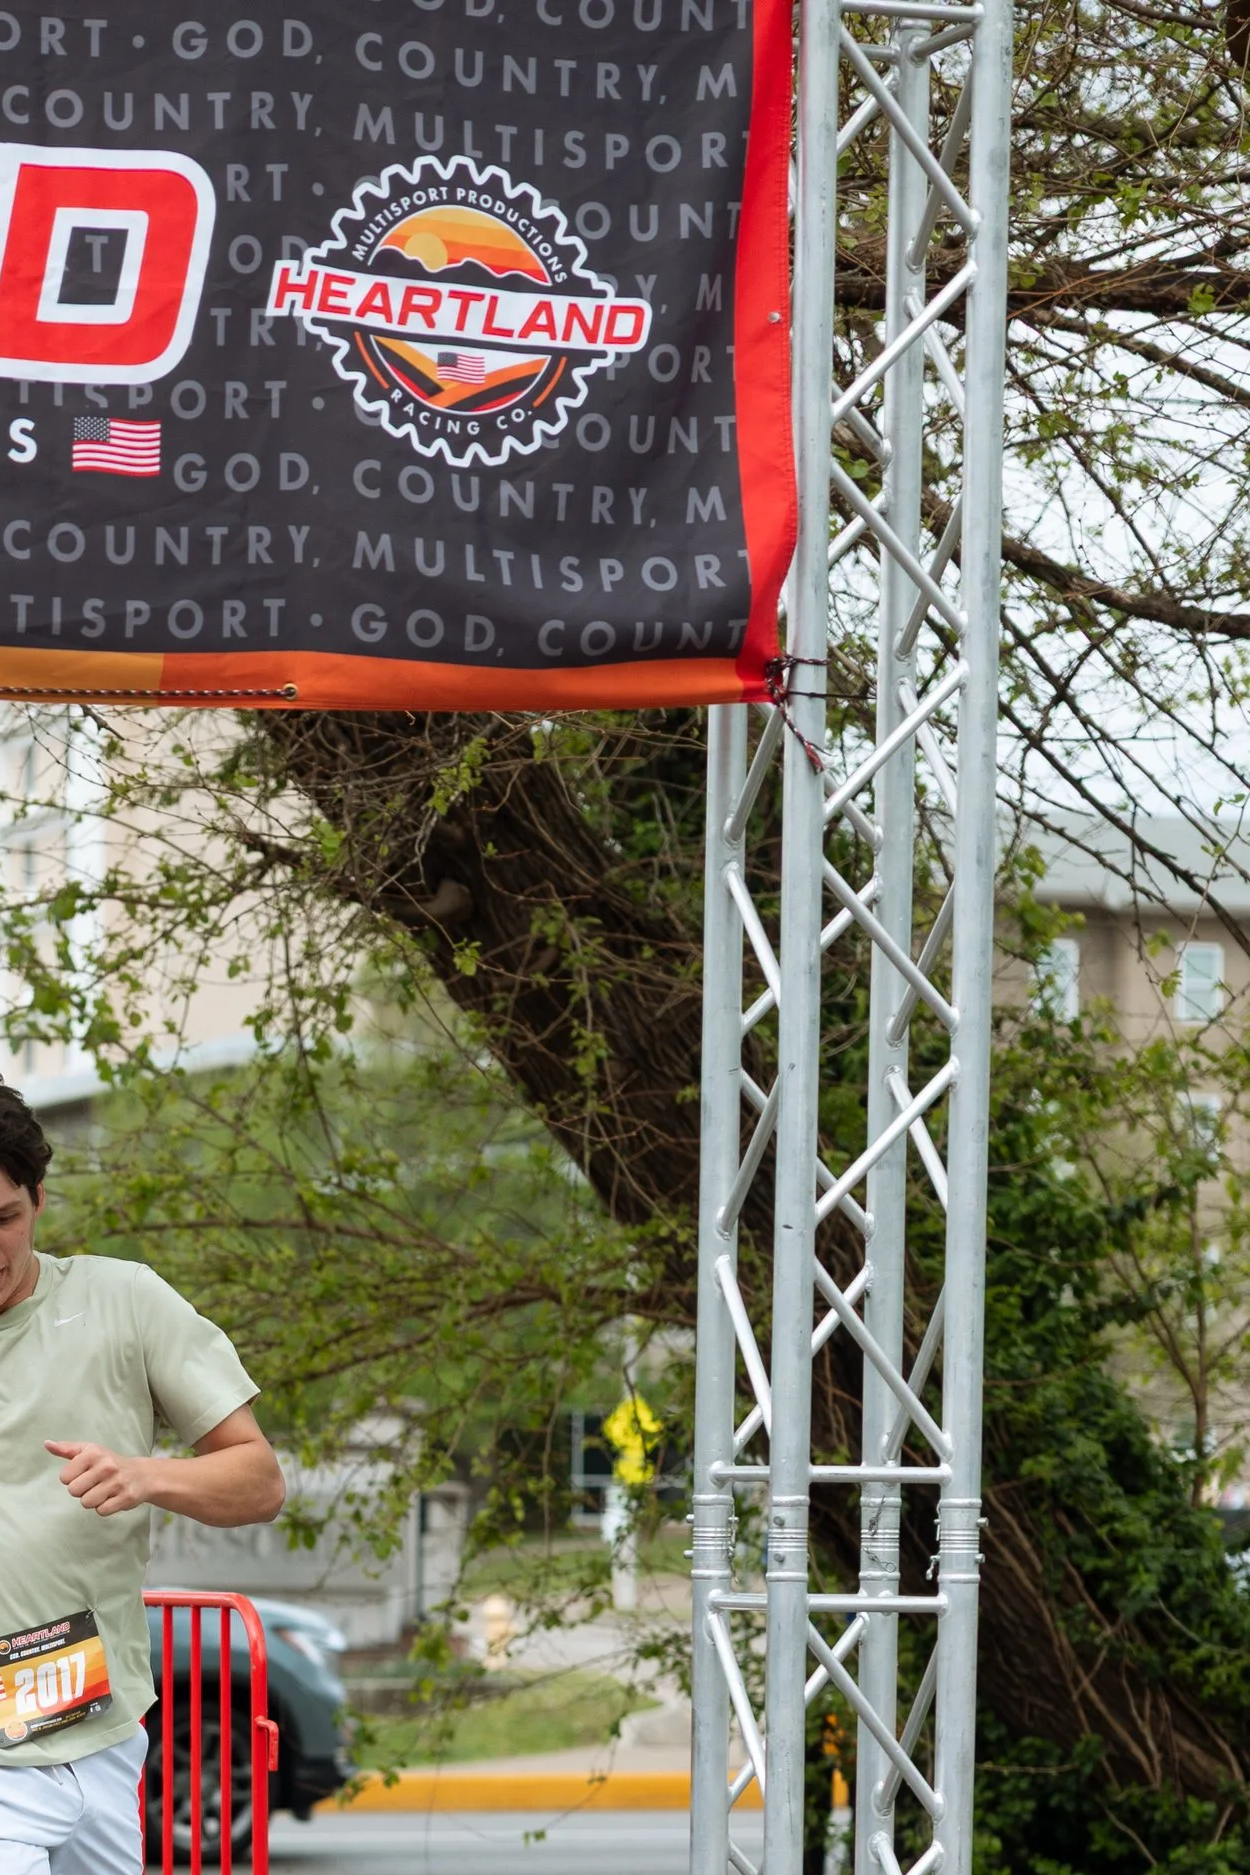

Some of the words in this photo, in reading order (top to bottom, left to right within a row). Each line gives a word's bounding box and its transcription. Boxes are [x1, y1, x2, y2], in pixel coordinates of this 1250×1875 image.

[172, 20, 322, 65] GOD,
[355, 32, 666, 104] COUNTRY,
[1, 84, 322, 137] COUNTRY,
[351, 186, 450, 263] MULTISPORT
[456, 186, 569, 284] PRODUCTIONS
[271, 265, 649, 347] HEARTLAND
[388, 387, 481, 436] RACING
[495, 408, 534, 431] CO.
[173, 452, 320, 495] GOD,
[353, 459, 656, 528] COUNTRY,
[2, 519, 321, 568] COUNTRY,
[351, 603, 505, 657] GOD,
[11, 1621, 71, 1649] HEARTLAND
[14, 1650, 86, 1716] 2017
